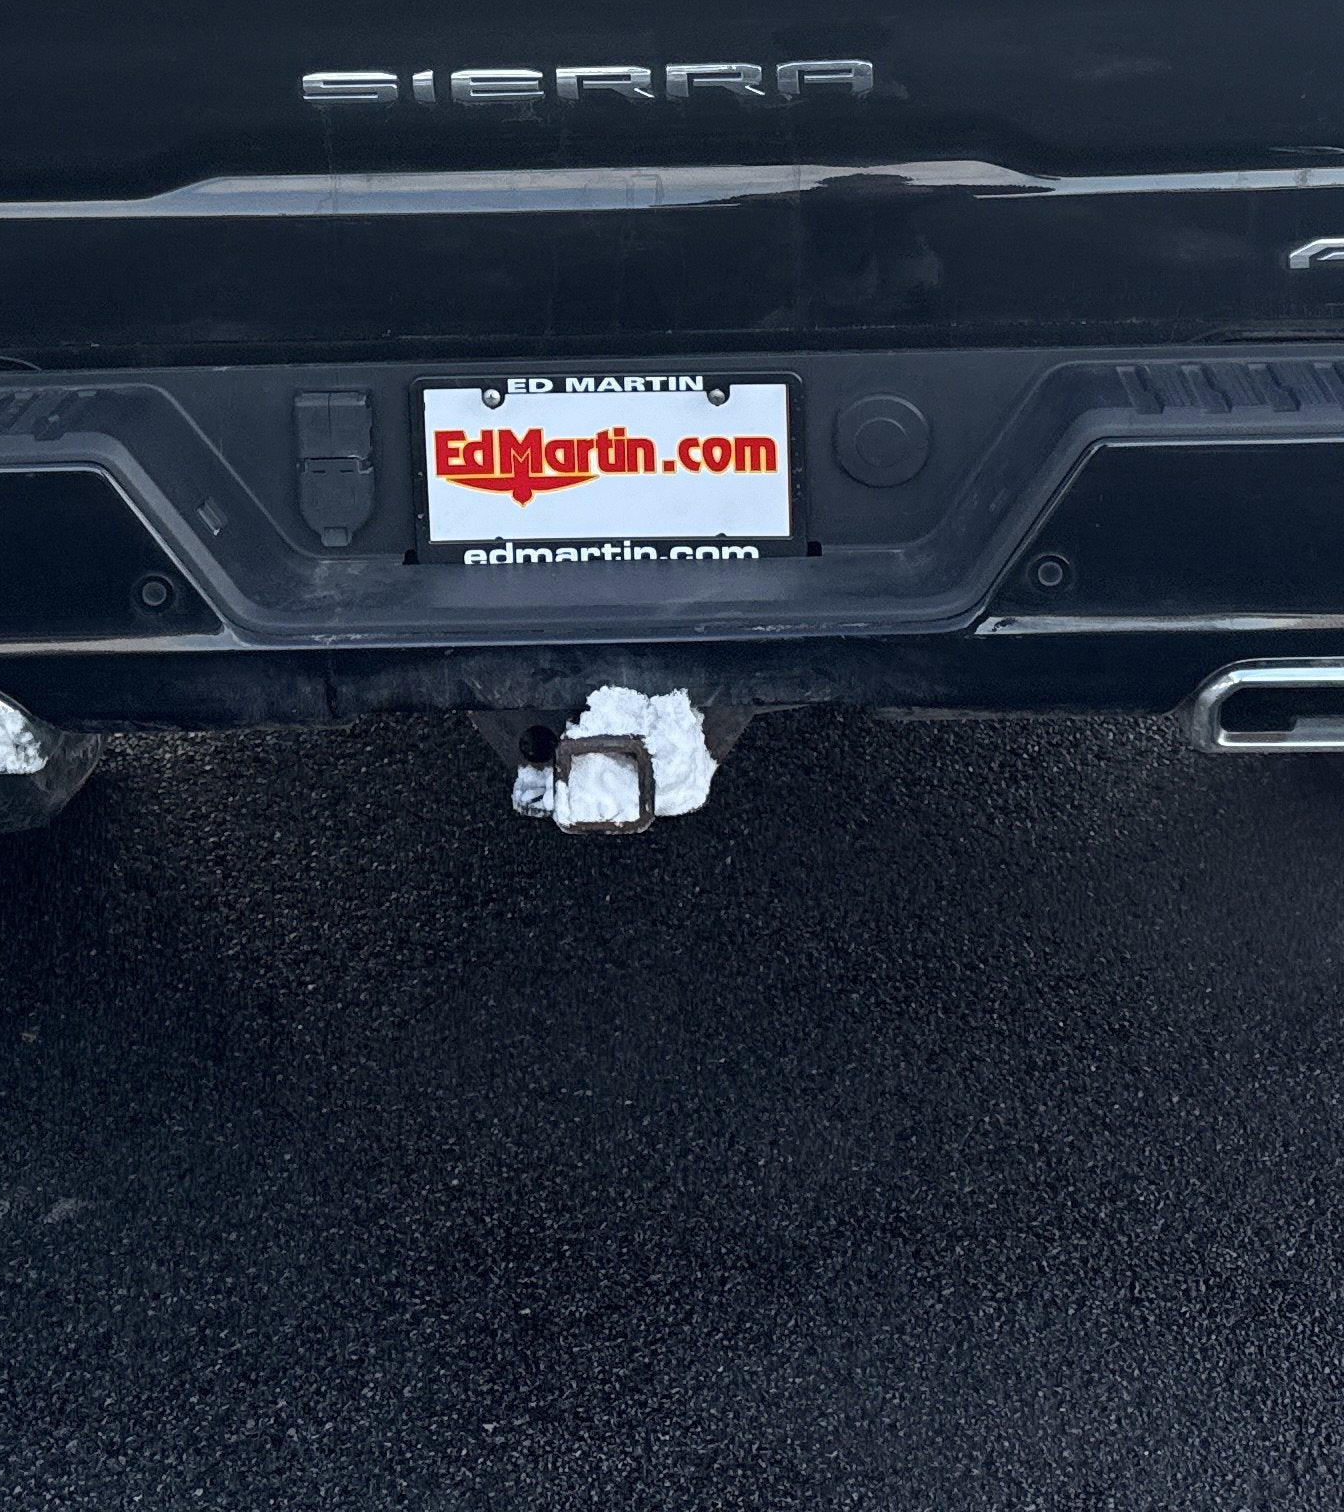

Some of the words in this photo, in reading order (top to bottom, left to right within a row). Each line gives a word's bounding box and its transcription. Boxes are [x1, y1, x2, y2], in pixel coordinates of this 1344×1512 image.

[302, 59, 874, 104] SIERRA
[507, 378, 554, 394] ED
[565, 375, 704, 393] MARTIN
[434, 426, 779, 480] EdMartin.com
[463, 540, 759, 565] edmartin.com
